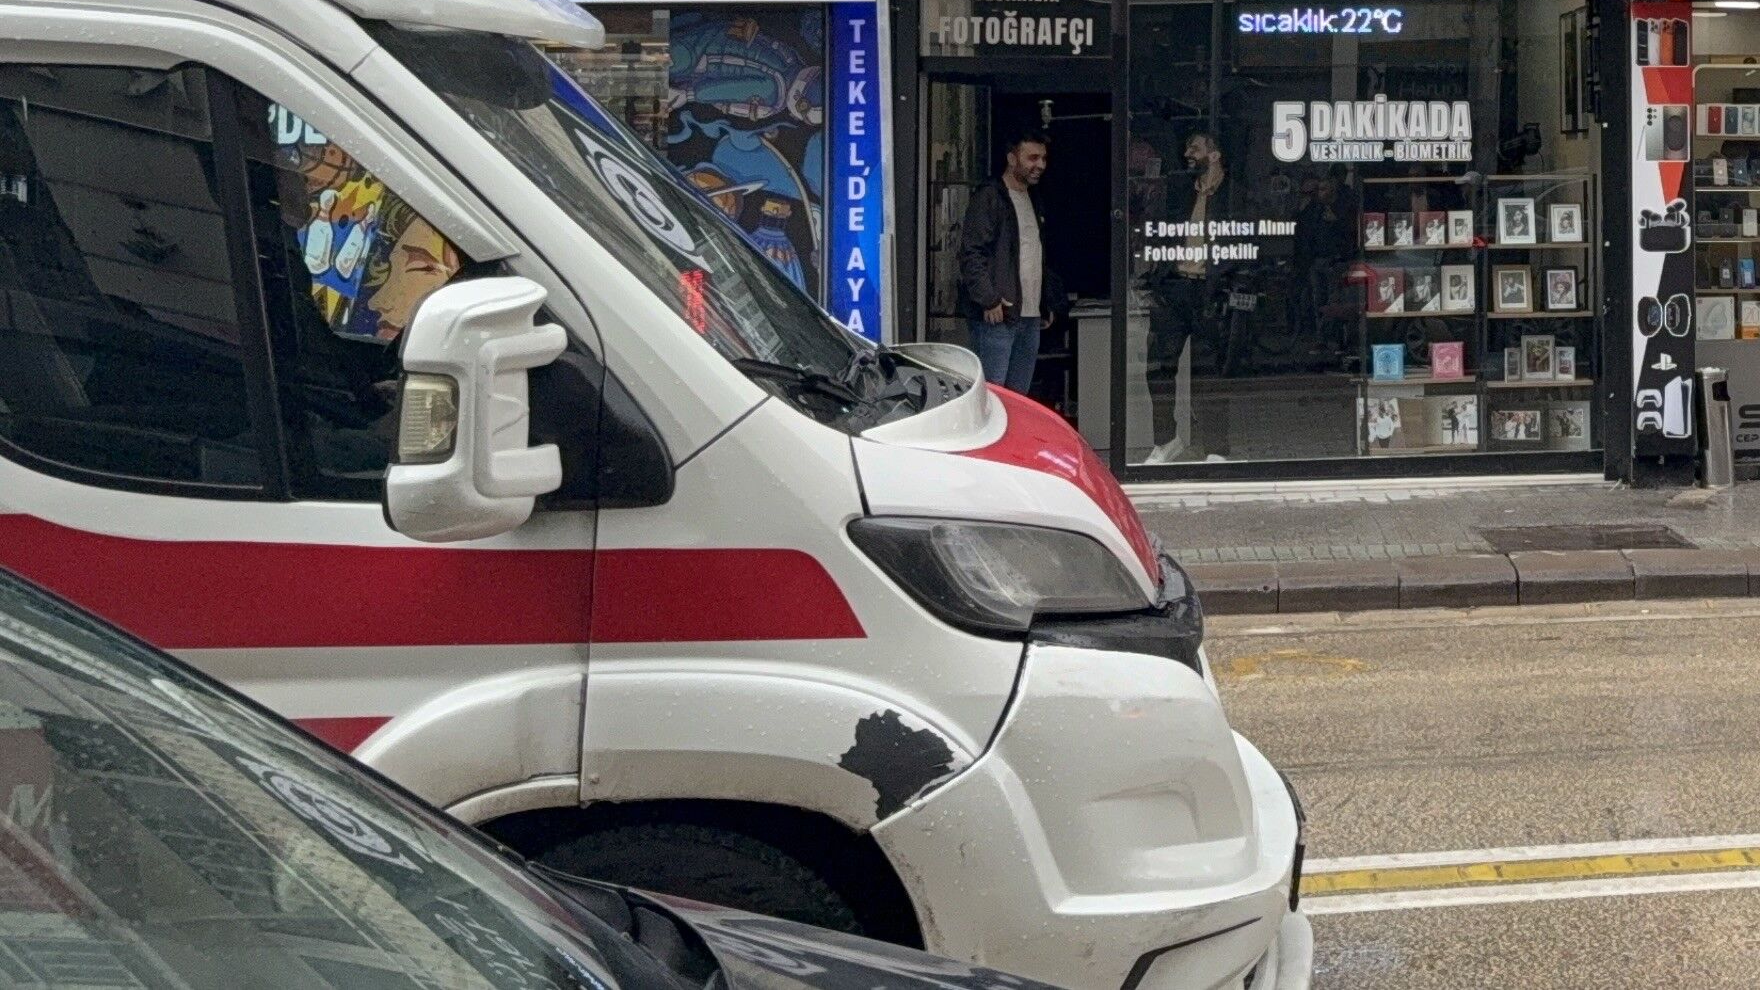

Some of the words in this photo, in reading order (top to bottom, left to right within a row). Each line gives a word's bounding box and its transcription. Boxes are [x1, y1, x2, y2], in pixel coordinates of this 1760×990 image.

[938, 10, 1094, 55] FOTOĞRAFÇI
[1271, 101, 1307, 162] 5
[1310, 94, 1473, 140] DAKİKADA
[1145, 220, 1205, 237] E-Devlet
[1144, 244, 1208, 263] Fotokopi
[1211, 243, 1260, 265] Çekilir
[1736, 433, 1759, 443] CEP
